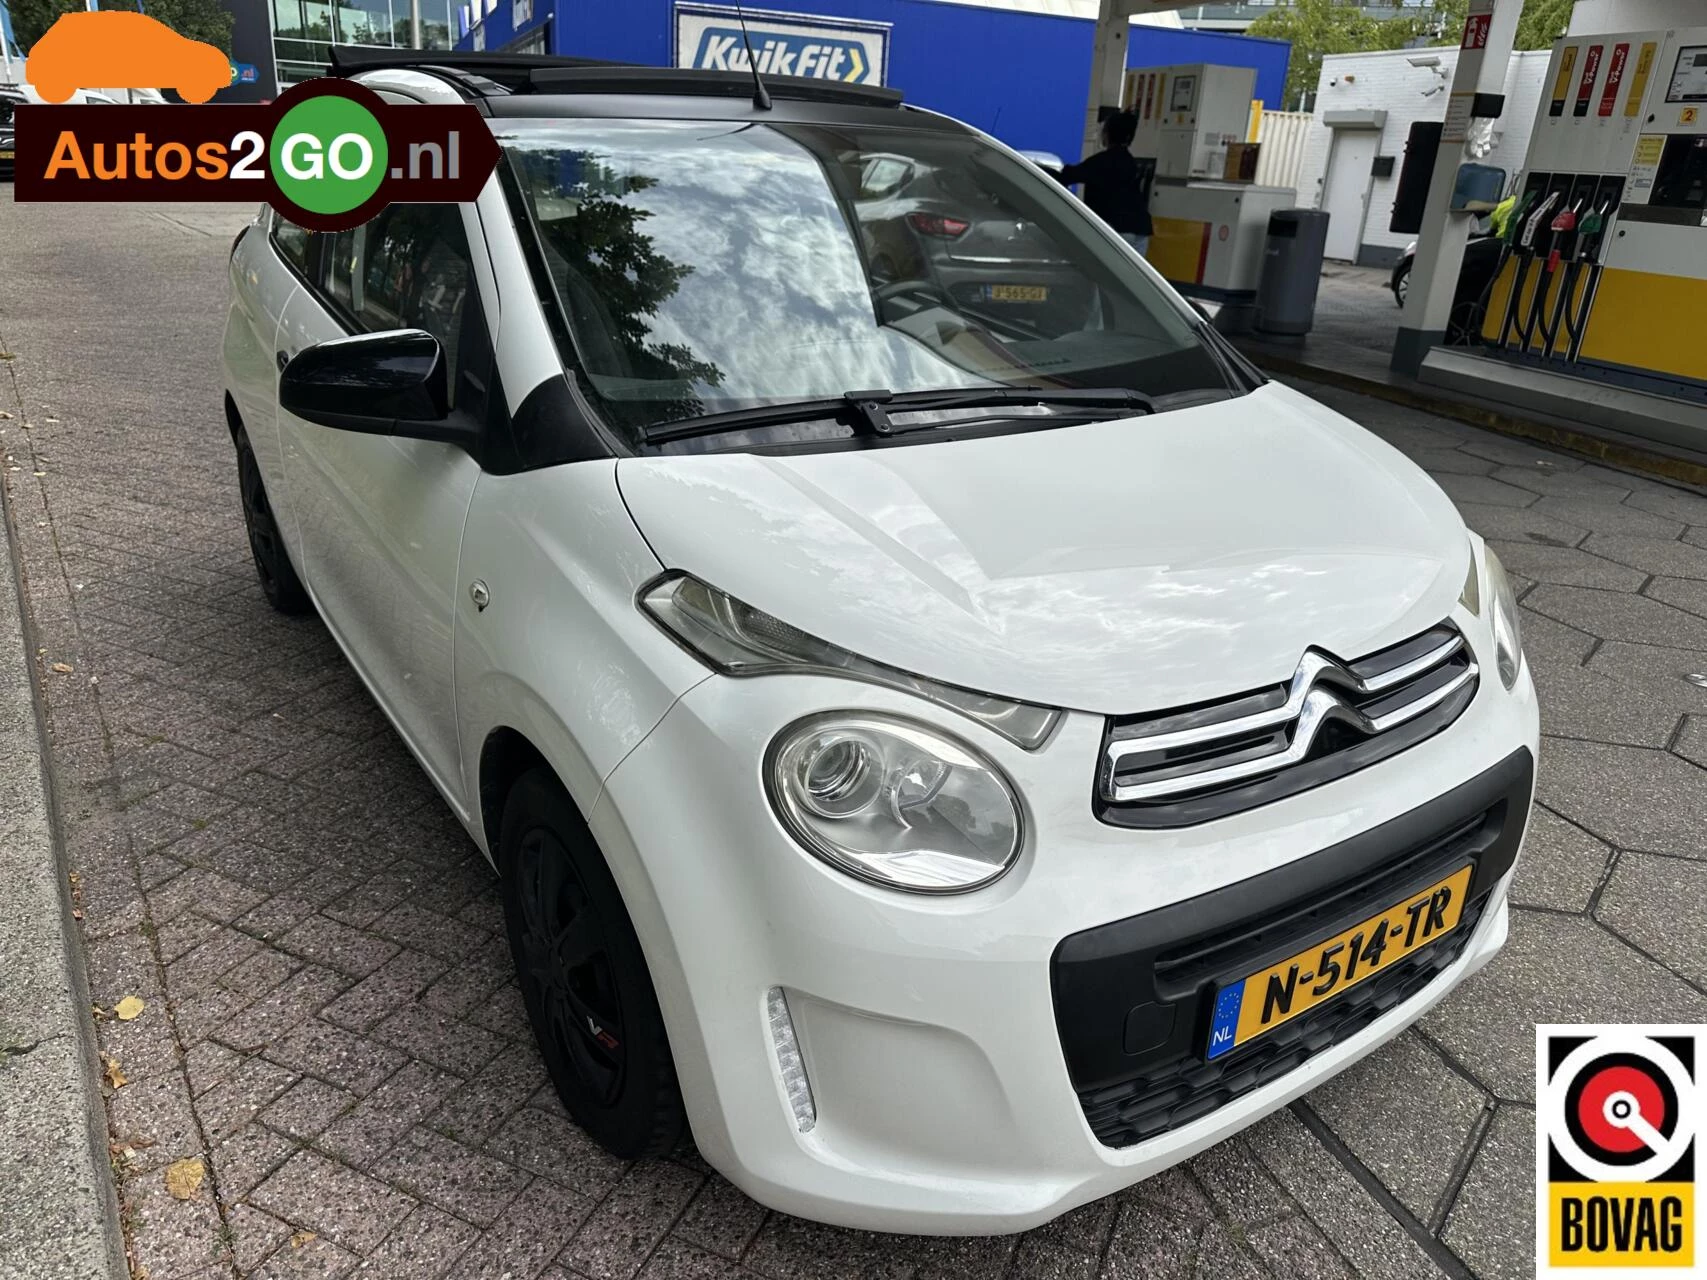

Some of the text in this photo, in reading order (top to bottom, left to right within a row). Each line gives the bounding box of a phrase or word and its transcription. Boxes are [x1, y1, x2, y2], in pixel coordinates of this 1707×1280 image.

[1685, 110, 1693, 121] 2
[1261, 886, 1452, 1024] N-514-TR
[1212, 1025, 1233, 1047] NL
